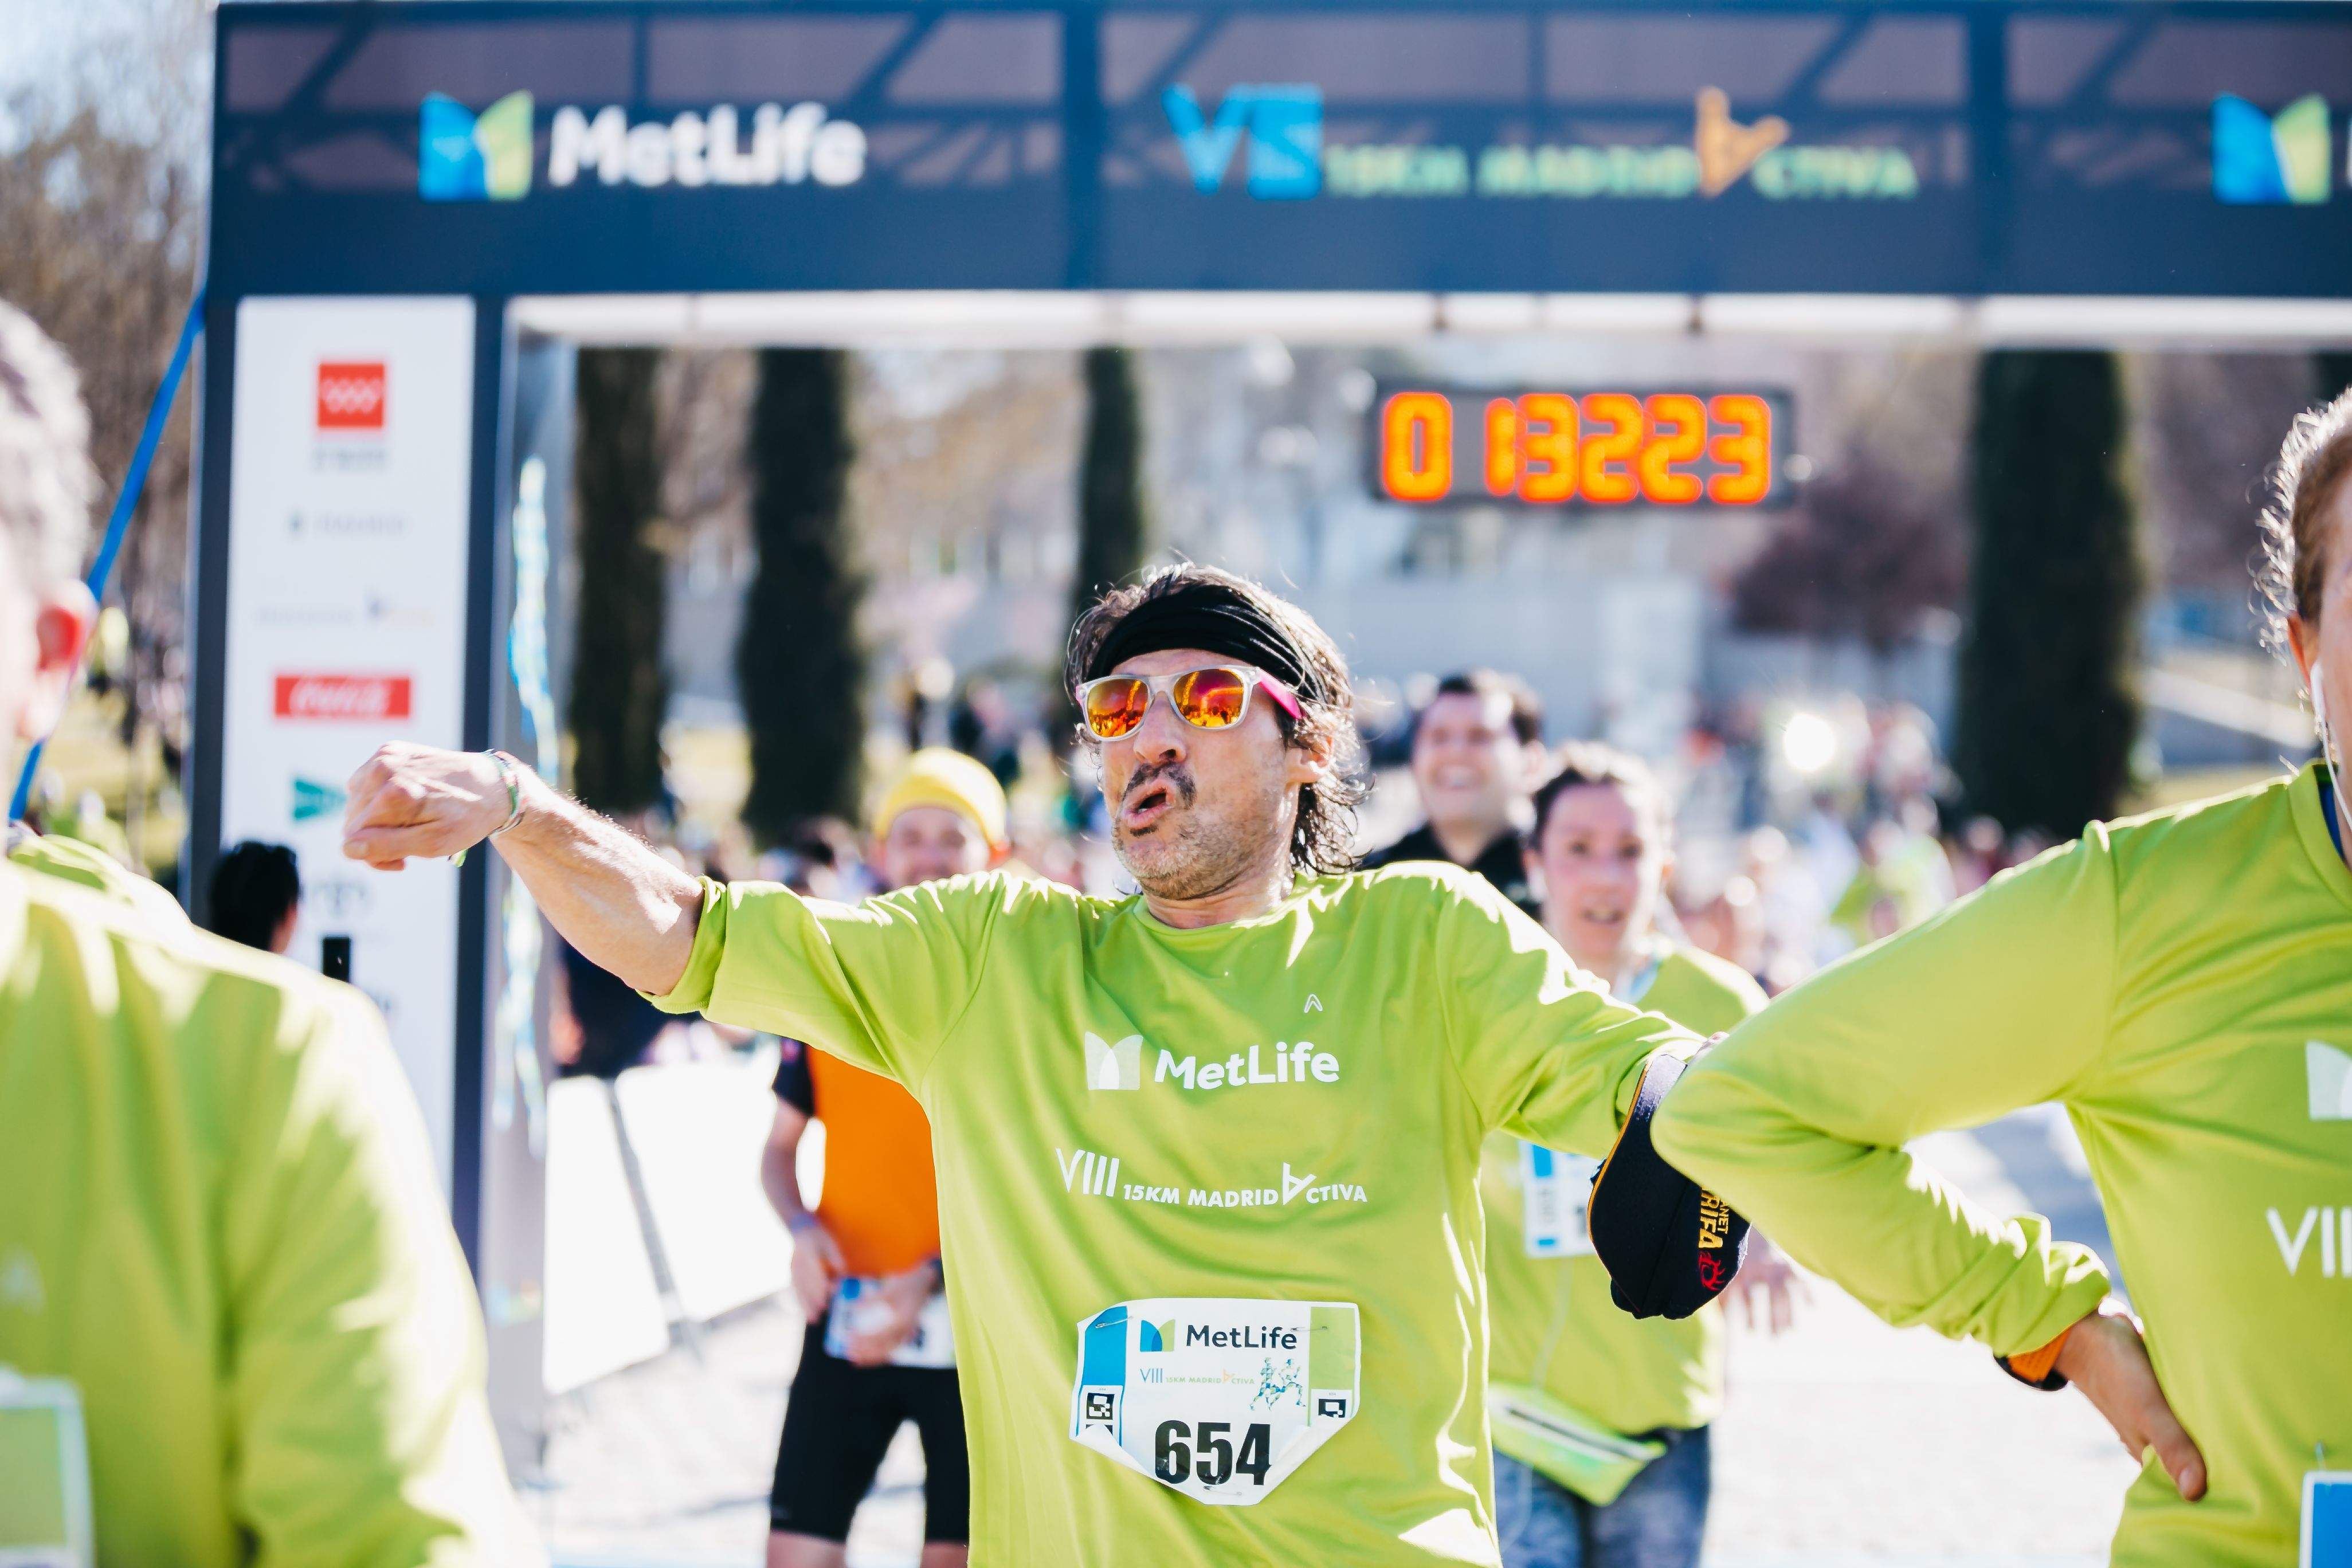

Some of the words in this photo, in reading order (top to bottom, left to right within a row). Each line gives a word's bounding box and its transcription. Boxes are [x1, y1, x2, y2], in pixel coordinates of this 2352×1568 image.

[548, 102, 867, 188] MetLife
[1382, 392, 1452, 502] 0
[1154, 1041, 1339, 1089] MetLife
[1056, 1148, 1120, 1197] VIII
[1123, 1183, 1179, 1205] 15KM
[1187, 1189, 1278, 1208] MADRID
[1186, 1325, 1297, 1350] MetLife
[1139, 1368, 1163, 1383] VIII
[1155, 1420, 1272, 1485] 654
